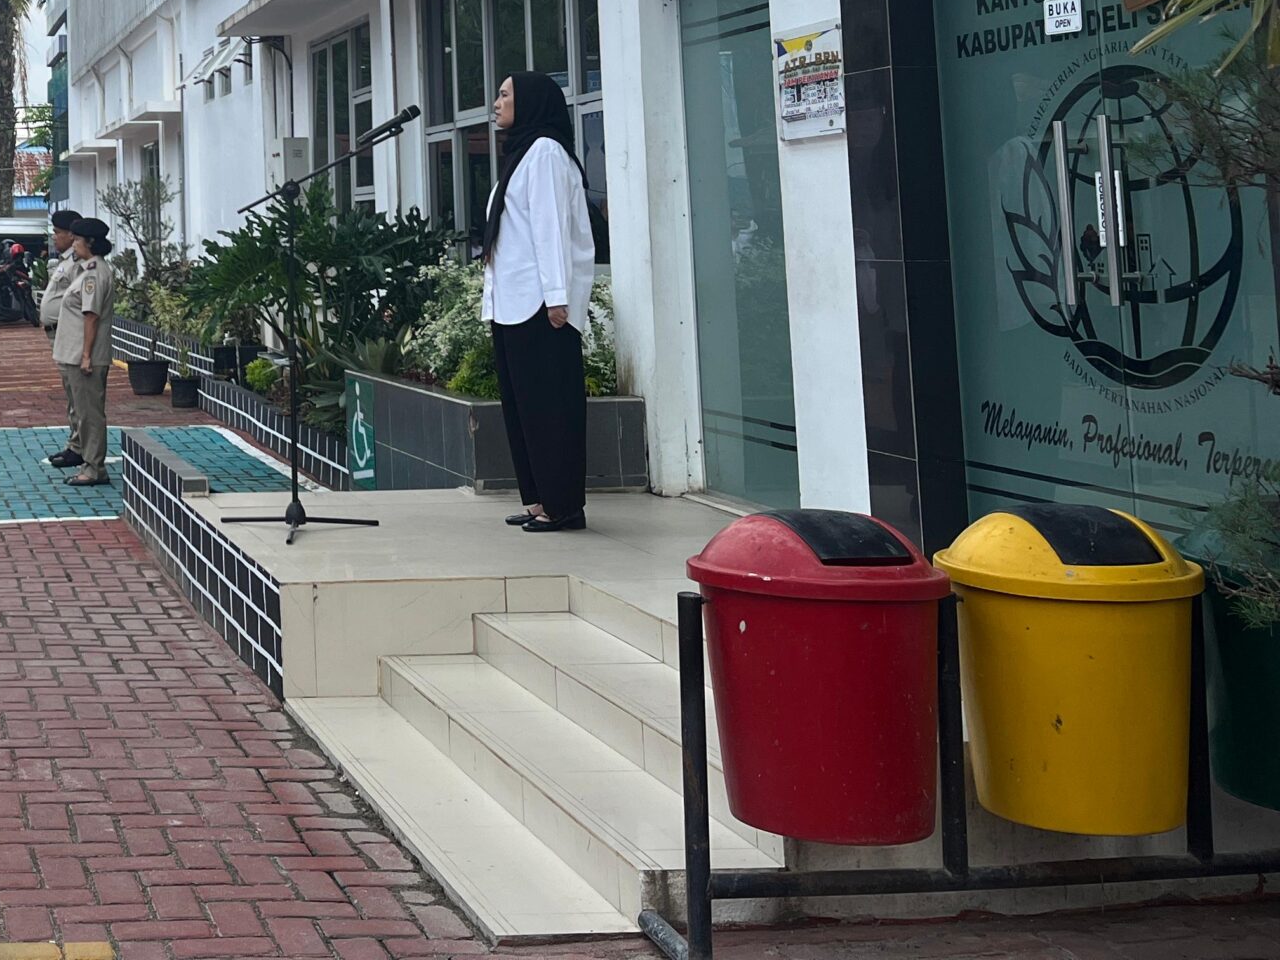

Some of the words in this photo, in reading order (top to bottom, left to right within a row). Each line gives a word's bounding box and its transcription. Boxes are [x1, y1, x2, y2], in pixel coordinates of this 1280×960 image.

[1048, 1, 1077, 17] BUKA
[1055, 19, 1071, 29] OPEN
[1086, 1, 1138, 37] DELI
[1027, 58, 1081, 140] KEMENTERIAN
[1082, 41, 1130, 65] AGRARIA
[1161, 47, 1189, 71] TATA
[1063, 352, 1096, 390] BADAN
[1098, 384, 1173, 415] PERTANAHAN
